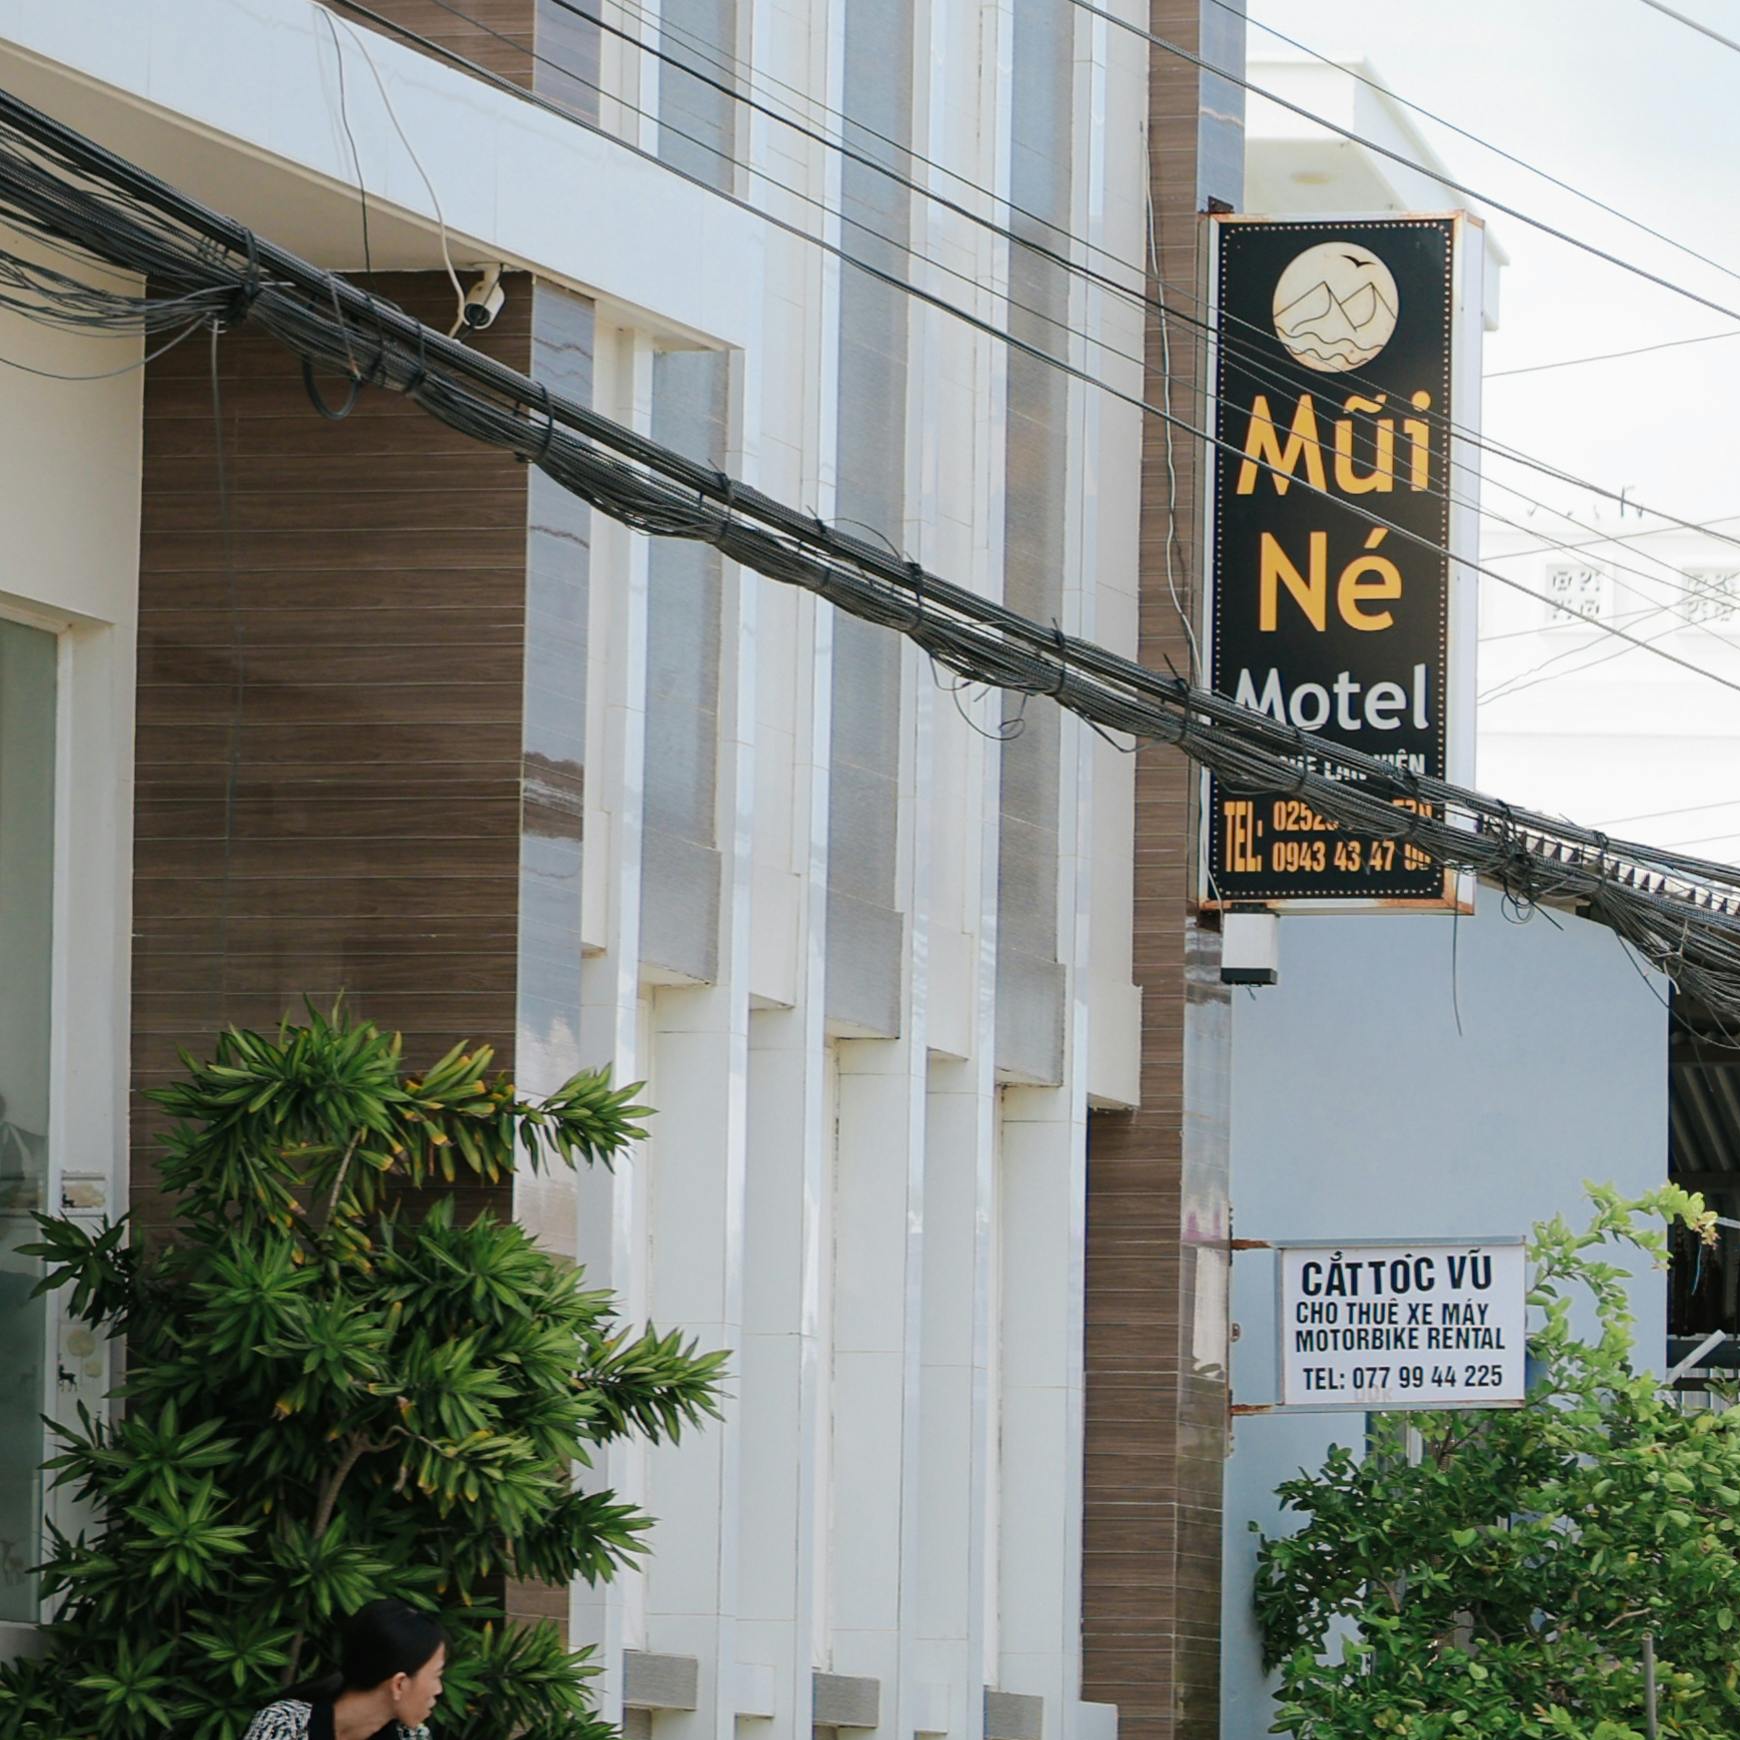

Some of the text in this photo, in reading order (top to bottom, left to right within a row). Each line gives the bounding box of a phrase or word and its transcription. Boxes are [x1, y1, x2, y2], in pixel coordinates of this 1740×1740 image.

[1236, 390, 1432, 496] Mũi
[1259, 527, 1402, 632] Né
[1234, 663, 1430, 731] Motel
[1224, 801, 1263, 872] TEL:
[1272, 841, 1326, 872] 0943
[1333, 840, 1361, 872] 43
[1369, 839, 1396, 872] 47
[1296, 1298, 1489, 1326] CHO THUÊ XE MÁY
[1295, 1327, 1506, 1352] MOTORBIKE RENTAL
[1303, 1365, 1503, 1390] TEL: 077 99 44 225
